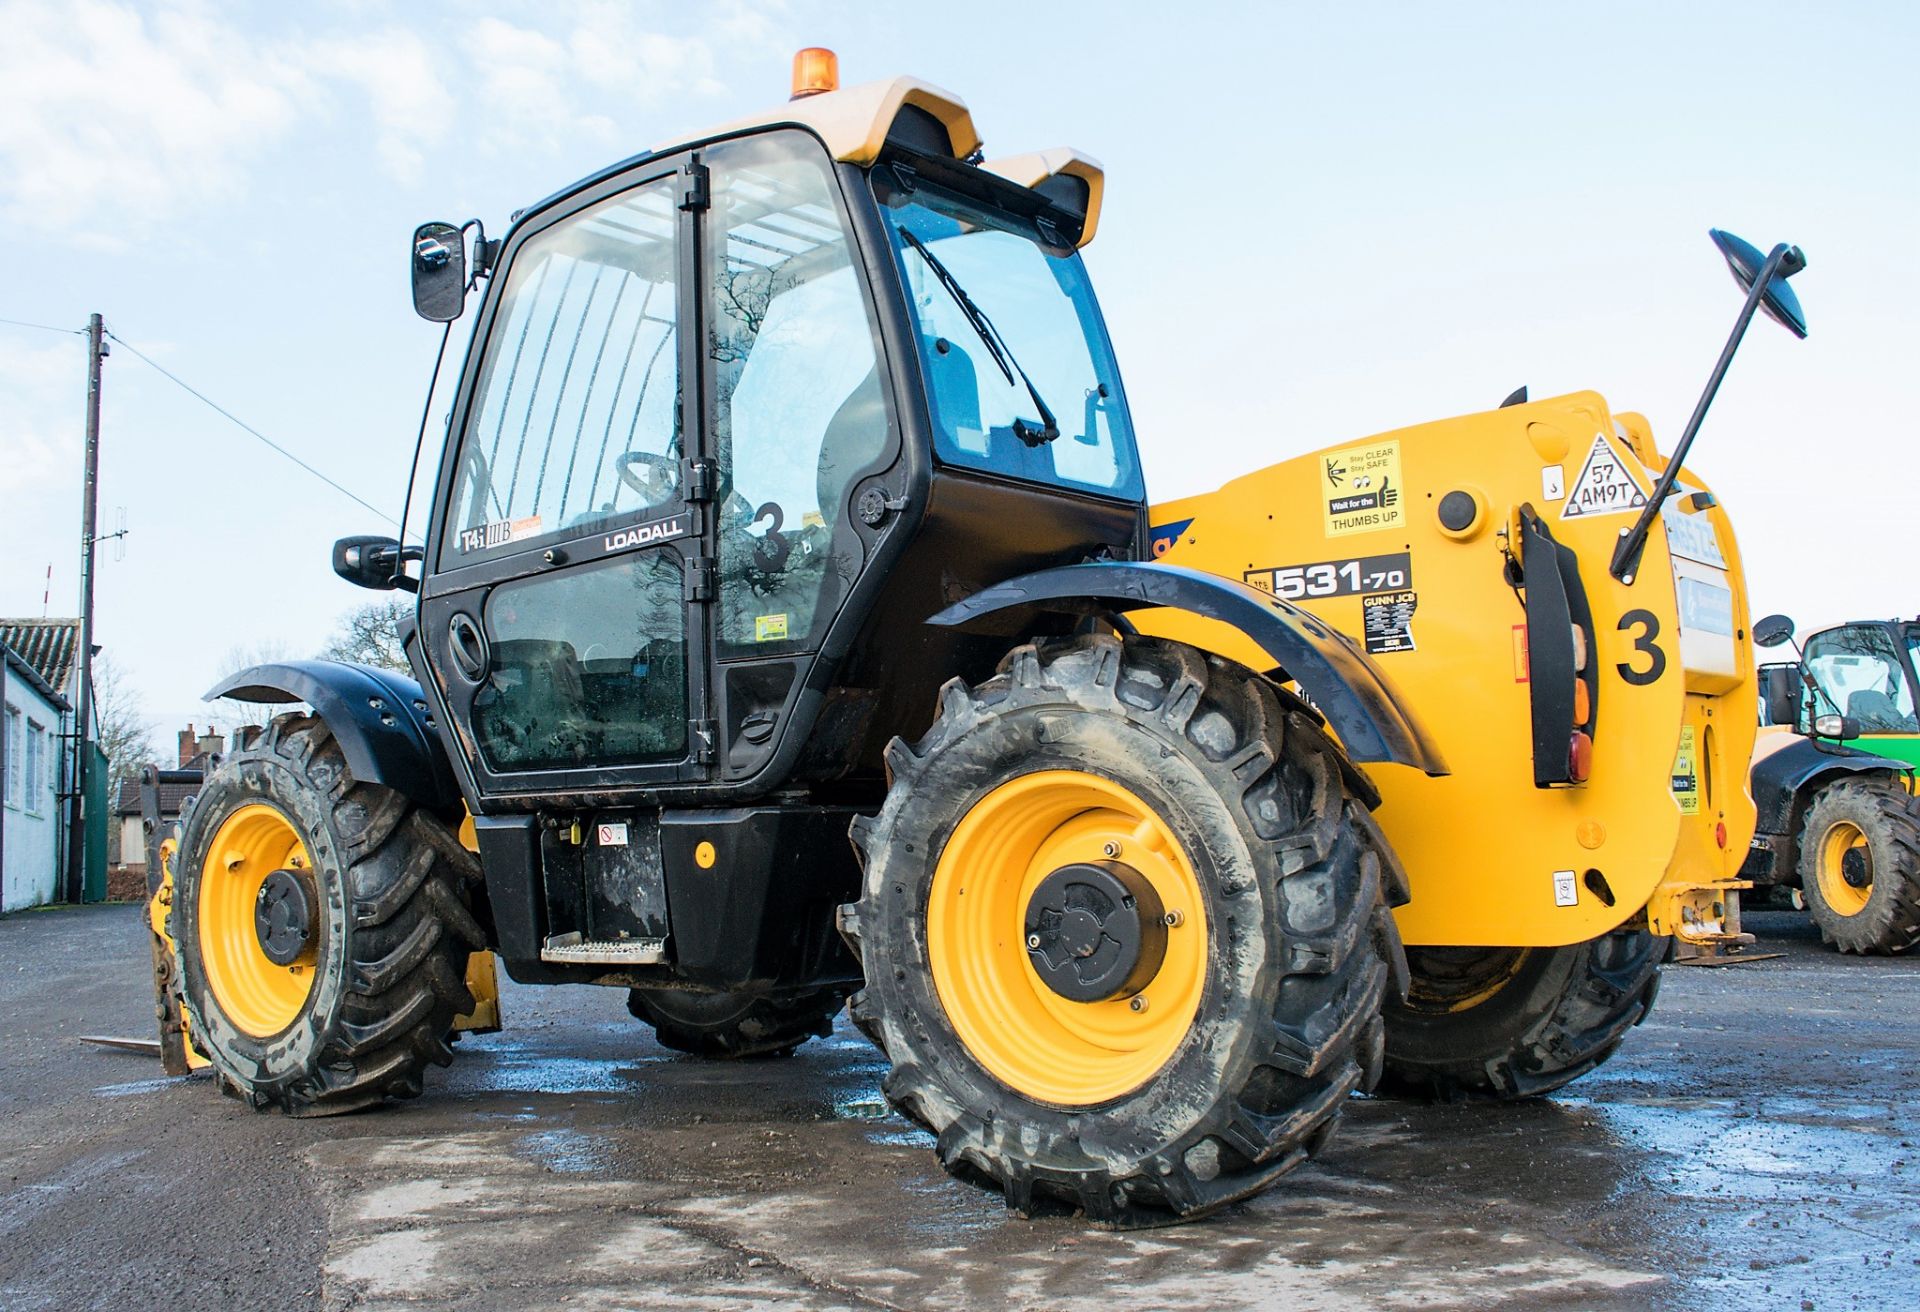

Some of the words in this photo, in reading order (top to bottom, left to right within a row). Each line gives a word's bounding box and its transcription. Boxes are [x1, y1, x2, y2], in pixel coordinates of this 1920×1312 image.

[1366, 449, 1393, 460] CLEAR
[1367, 459, 1388, 470] SAFE
[1592, 464, 1614, 484] 57
[1582, 483, 1629, 505] AM9T
[1331, 500, 1348, 511] Wait
[1350, 499, 1360, 508] for
[1361, 498, 1373, 507] the
[1333, 514, 1380, 530] THUMBS
[1383, 511, 1398, 522] UP
[462, 528, 486, 551] T4i
[605, 520, 683, 551] LOADALL
[753, 502, 789, 573] 3
[1364, 595, 1395, 607] GUNN
[1396, 593, 1415, 603] JCB
[1616, 608, 1666, 686] 3
